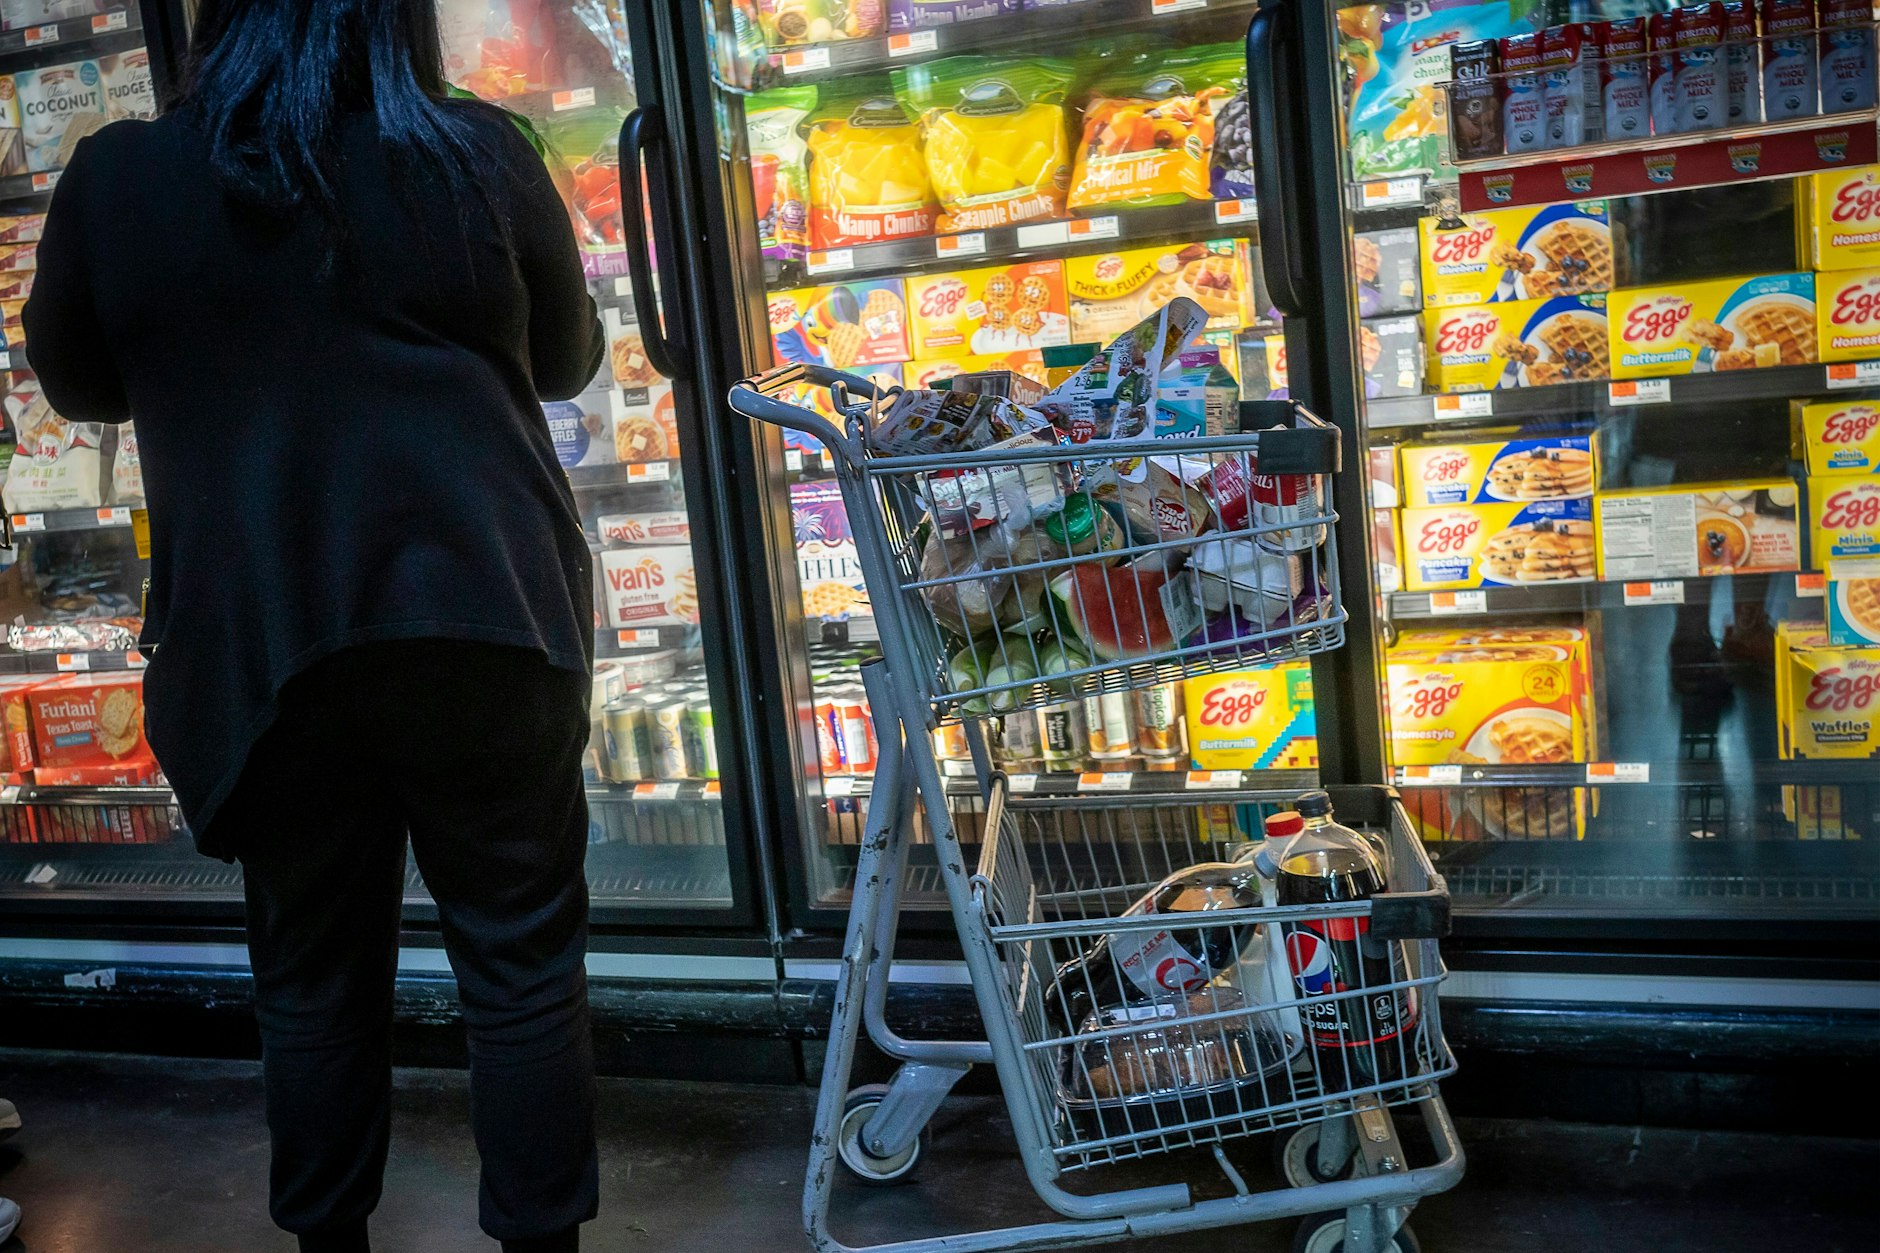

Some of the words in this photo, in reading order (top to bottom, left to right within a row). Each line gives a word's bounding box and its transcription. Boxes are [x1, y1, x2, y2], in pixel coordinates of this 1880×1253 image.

[1675, 25, 1719, 40] HORIZON
[1414, 54, 1451, 66] mang
[1413, 64, 1452, 79] chunk
[1457, 61, 1489, 79] Silk
[109, 80, 146, 102] FUDGE
[1682, 79, 1715, 89] WHOLE
[1687, 88, 1713, 97] MILK
[1611, 90, 1643, 100] WHOLE
[1617, 99, 1641, 108] MILK
[26, 92, 97, 117] COCONUT
[1136, 160, 1161, 183] Mix
[1009, 194, 1054, 222] Chunks
[838, 212, 882, 240] Mango
[883, 205, 930, 232] Chunks
[1433, 226, 1497, 263] Eggo
[1096, 259, 1124, 280] Eggo
[1437, 263, 1489, 276] Blueberry
[1074, 280, 1109, 297] THICK
[1116, 261, 1156, 295] FLUFFY
[920, 285, 968, 318] Eggo
[1623, 303, 1694, 342] Eggo
[1435, 318, 1500, 353] Eggo
[1440, 354, 1491, 366] Blueberry
[1621, 348, 1692, 367] Buttermilk
[1822, 412, 1880, 443] Eggo
[1834, 449, 1863, 459] Minis
[1423, 455, 1470, 481] Eggo
[1424, 483, 1471, 493] Pancakes
[1418, 518, 1481, 553] Eggo
[1839, 534, 1874, 545] Minis
[1417, 556, 1474, 569] Pancakes
[621, 594, 643, 606] gluten
[644, 593, 659, 601] free
[625, 606, 659, 616] ORIGINAL
[1532, 676, 1556, 690] 24
[39, 698, 97, 720] Furlani
[1152, 686, 1167, 733] Tropicana
[1200, 686, 1267, 726] Eggo
[46, 722, 71, 737] Texas
[71, 720, 94, 734] Toast
[1048, 720, 1058, 745] Maid
[1055, 715, 1066, 749] Minute
[1811, 720, 1871, 733] Waffles
[1199, 737, 1258, 750] Buttermilk
[1393, 729, 1456, 743] Homestyle
[1154, 930, 1168, 943] ME
